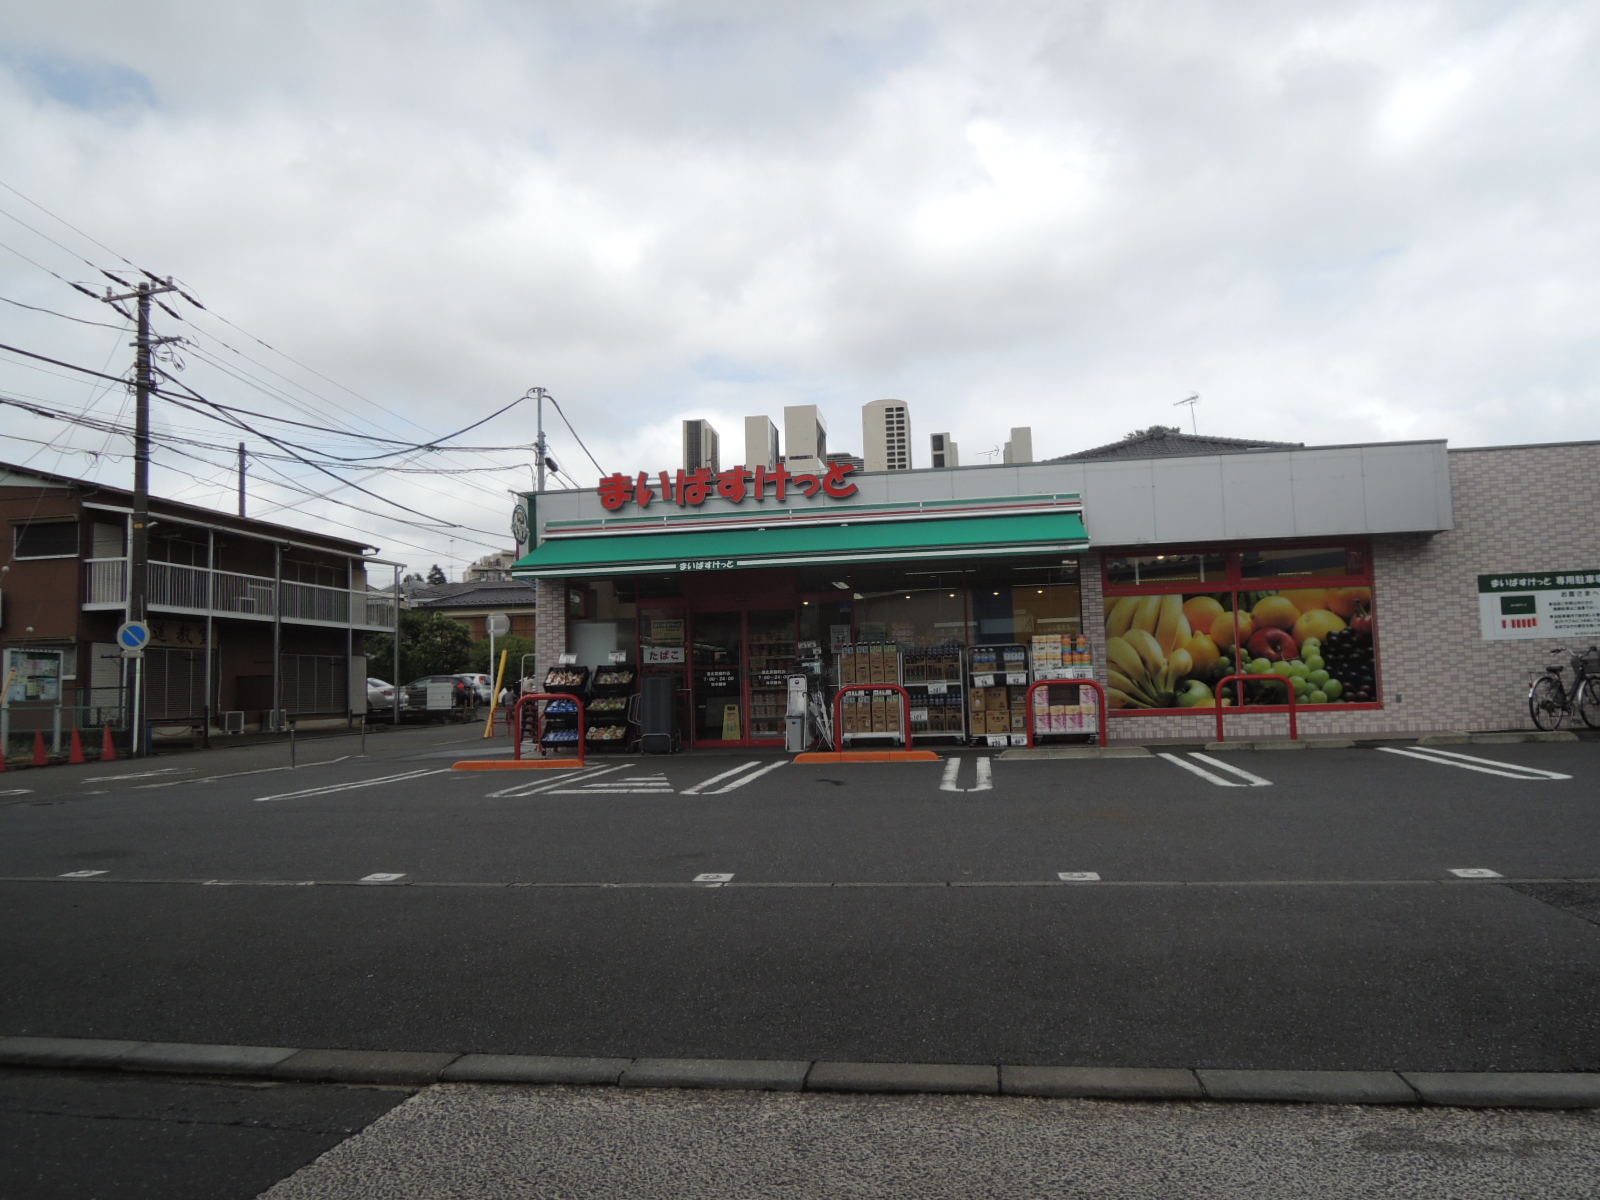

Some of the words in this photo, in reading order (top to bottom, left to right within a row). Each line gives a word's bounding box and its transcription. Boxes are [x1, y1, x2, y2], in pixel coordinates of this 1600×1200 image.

[598, 461, 859, 510] まいばすけっと
[679, 560, 734, 570] まいばすけっと
[1491, 578, 1552, 588] まいばすけっと
[649, 649, 679, 661] たばこ
